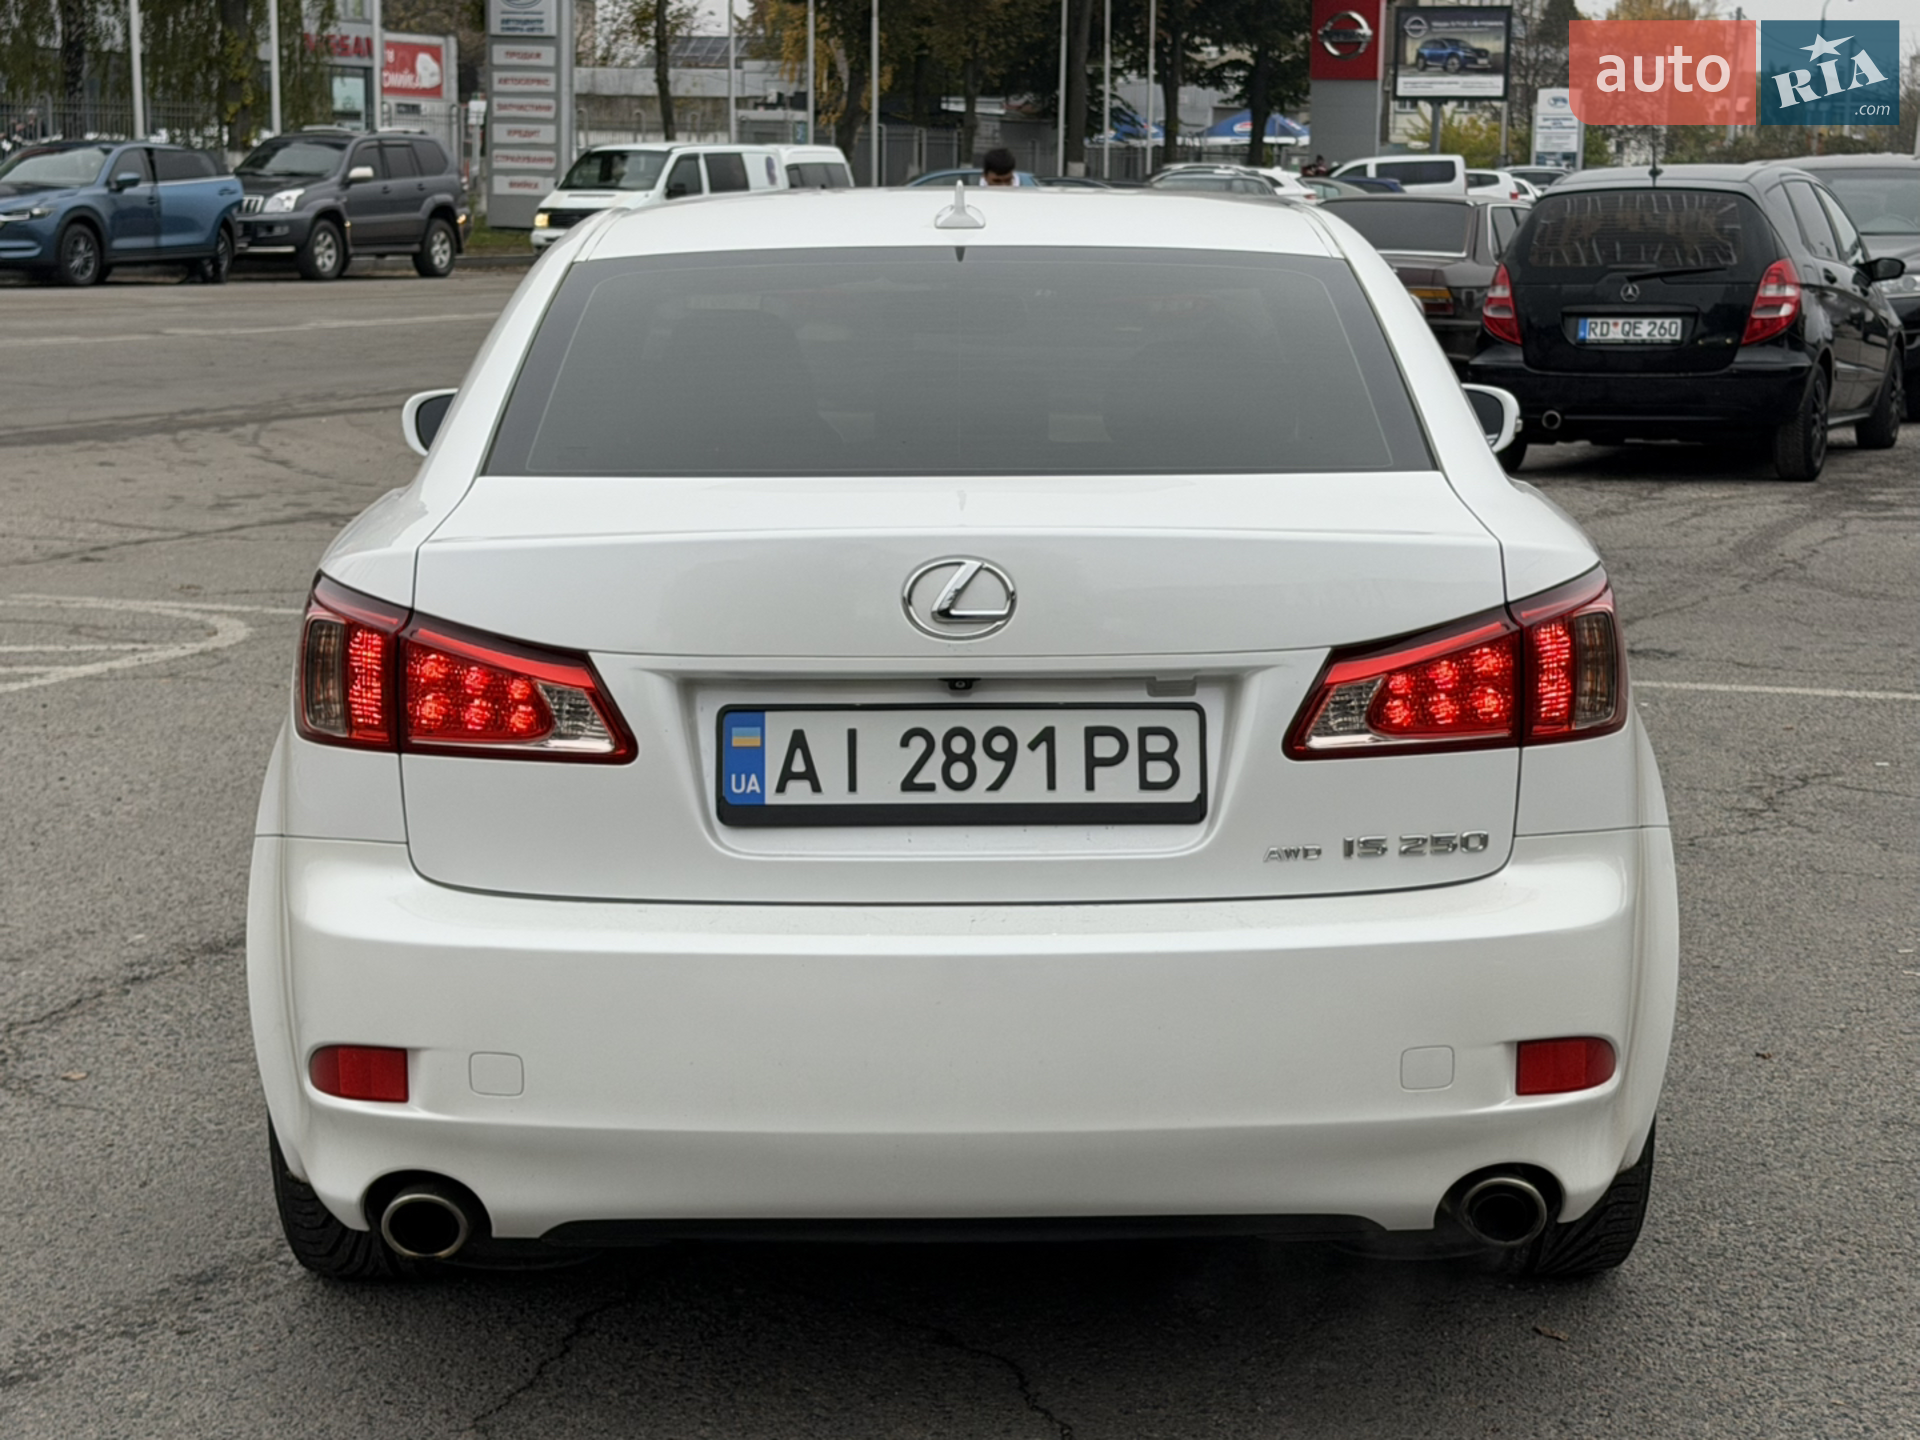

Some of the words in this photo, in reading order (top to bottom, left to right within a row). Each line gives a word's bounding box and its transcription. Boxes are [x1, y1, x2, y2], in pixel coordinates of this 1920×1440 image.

[1588, 321, 1610, 337] RD
[1621, 321, 1644, 338] QE
[1647, 321, 1679, 337] 260
[775, 728, 857, 794] AI
[899, 726, 1056, 792] 2891
[1084, 726, 1181, 792] PB
[731, 773, 761, 793] UA
[1263, 844, 1322, 862] AWD
[1343, 836, 1388, 860] IS
[1398, 830, 1490, 857] 250
